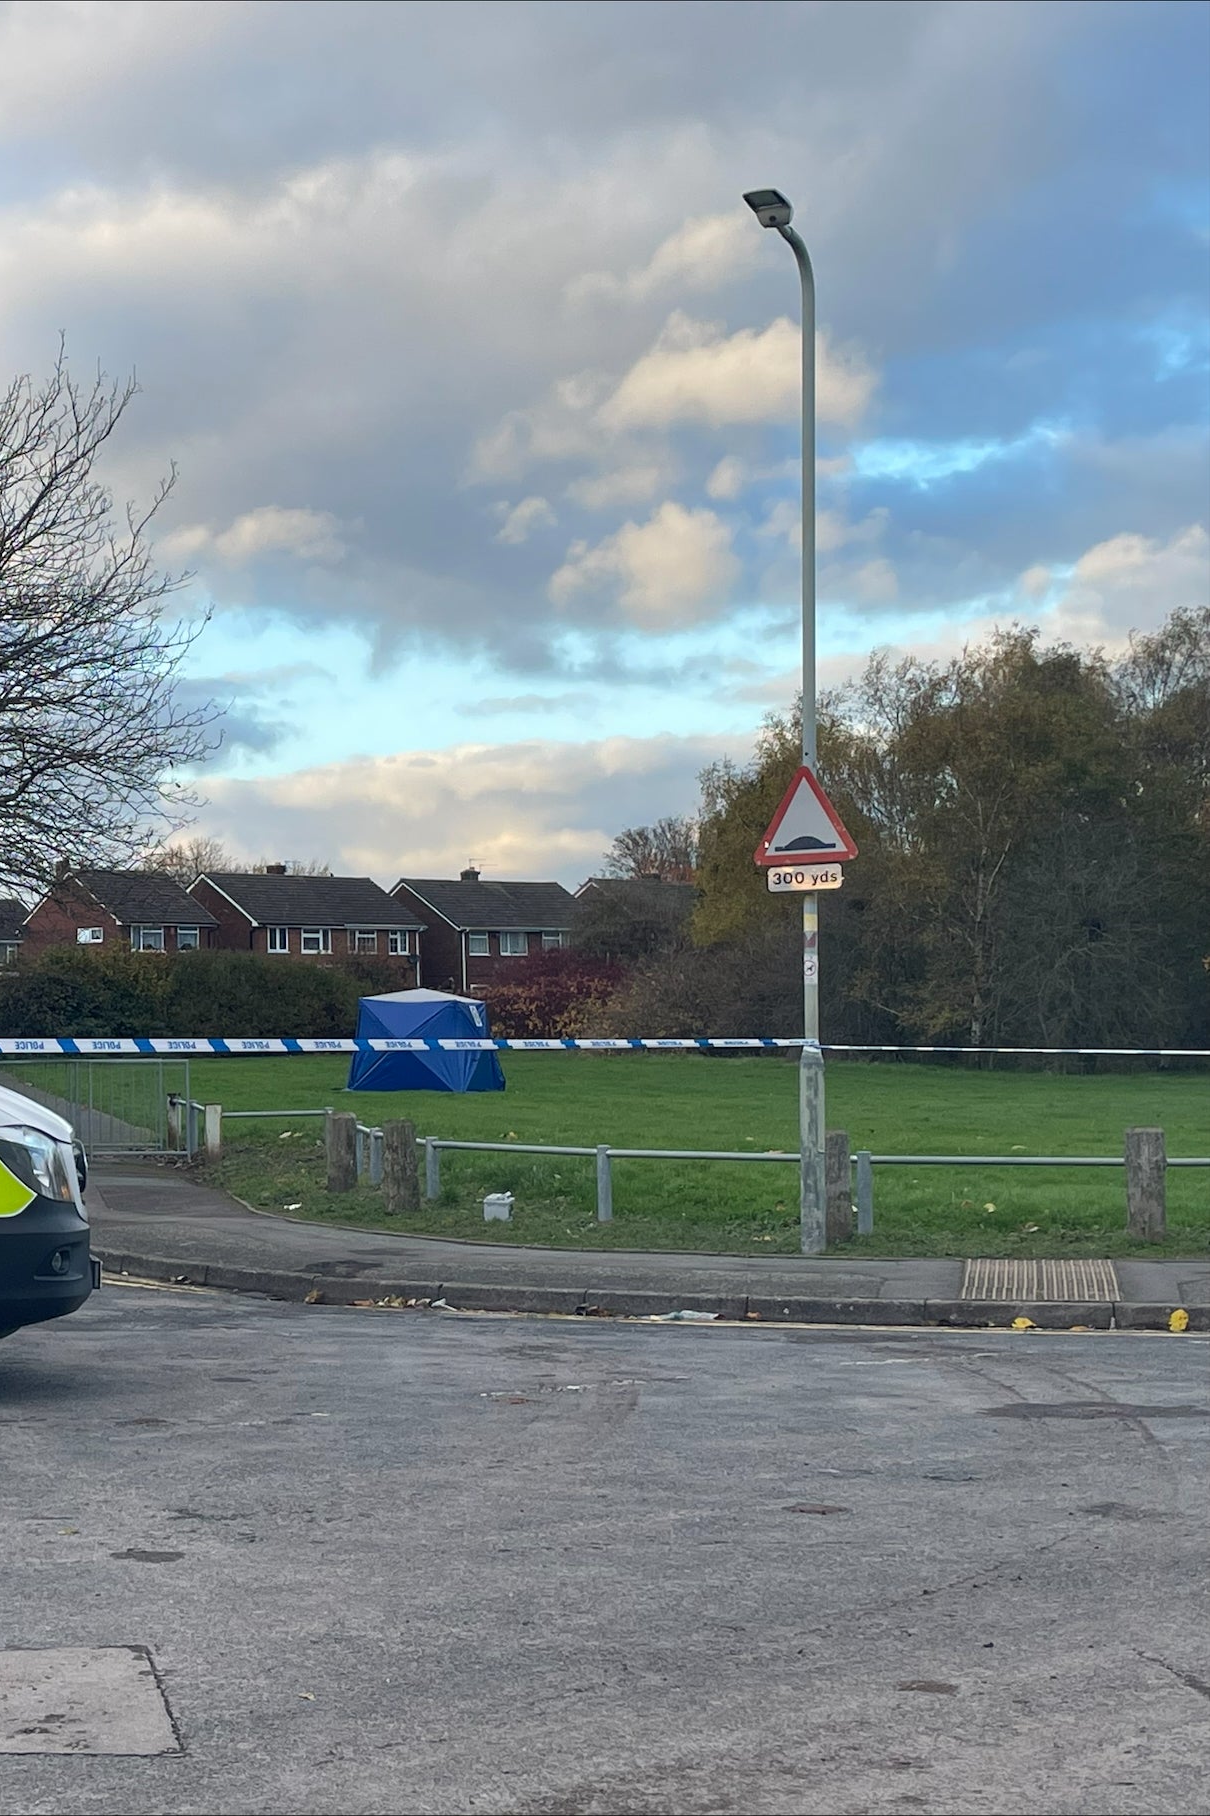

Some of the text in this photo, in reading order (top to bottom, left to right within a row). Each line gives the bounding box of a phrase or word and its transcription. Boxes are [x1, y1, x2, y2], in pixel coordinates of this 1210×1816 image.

[772, 871, 838, 886] 300 yds
[15, 1041, 44, 1050] POLICE
[92, 1041, 121, 1050] POLICE
[167, 1041, 196, 1050] POLICE
[242, 1041, 270, 1049] POLICE
[314, 1041, 342, 1049] POLICE
